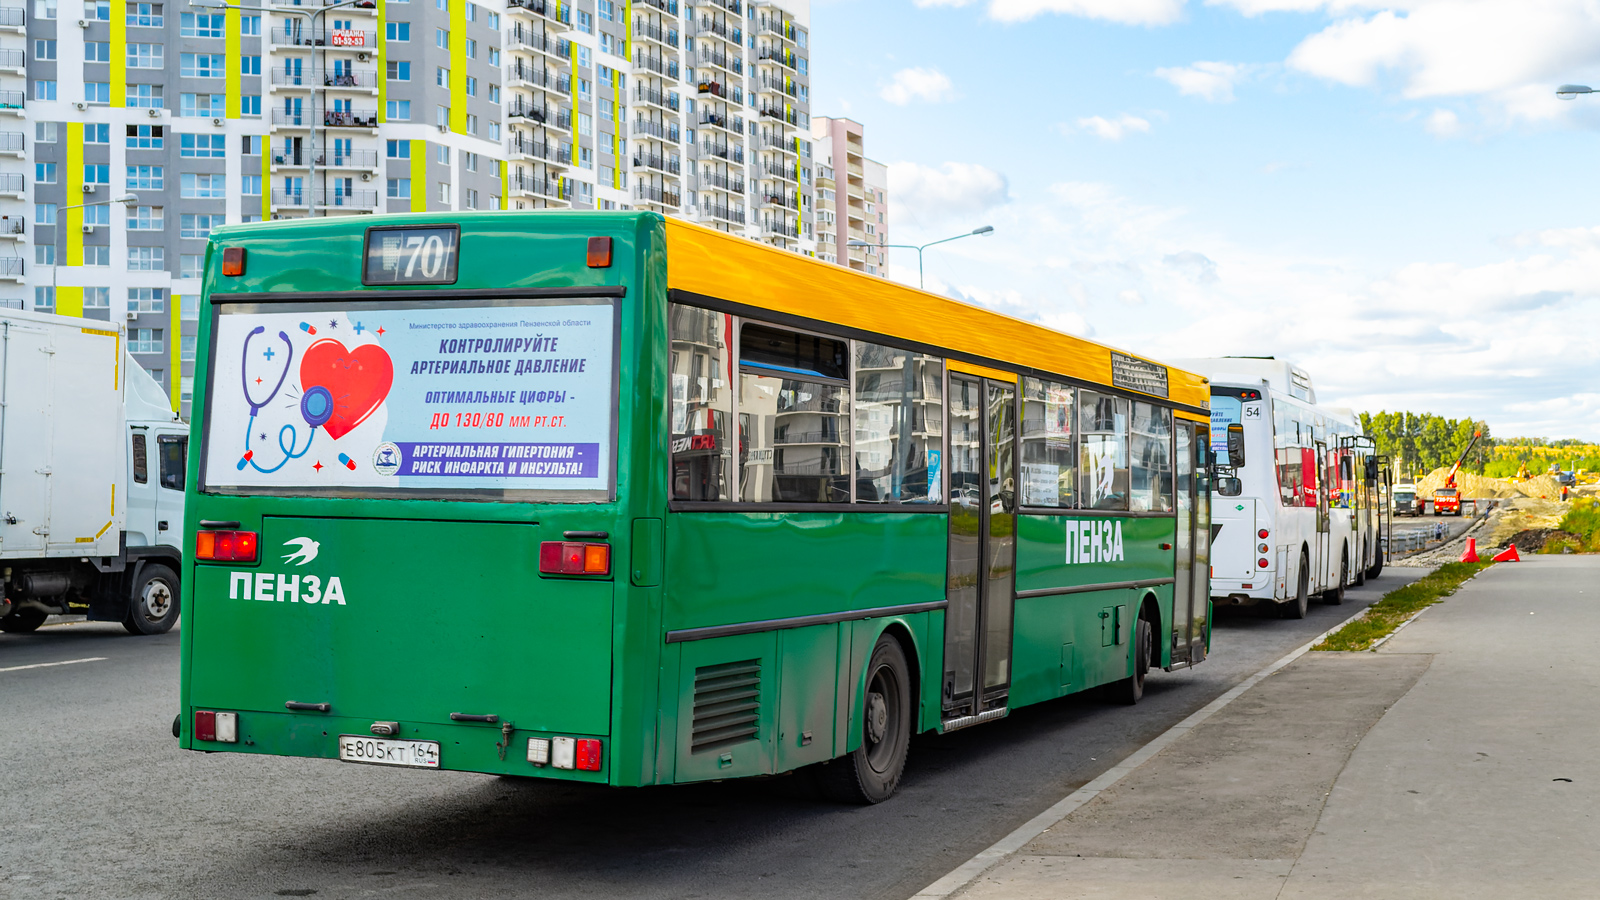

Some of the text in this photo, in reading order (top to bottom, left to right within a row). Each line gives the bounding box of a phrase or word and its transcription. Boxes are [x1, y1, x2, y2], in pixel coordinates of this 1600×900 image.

[404, 235, 444, 278] 70
[409, 319, 592, 330] Министерство здравоохранения Пензенской области
[439, 334, 558, 354] КОНТРОЛИРУЙТЕ
[410, 358, 586, 376] АРТЕРИАЛЬНОЕ ДАВЛЕНИЕ
[425, 390, 516, 404] ОПТИМАЛЬНЫЕ
[519, 390, 566, 406] ЦИФРЫ
[1246, 408, 1260, 416] 54
[430, 413, 450, 430] ДО
[455, 412, 504, 428] 130/80
[534, 416, 567, 428] РТ.СТ.
[412, 445, 498, 458] АРТЕРИАЛЬНАЯ
[502, 446, 575, 458] ГИПЕРТОНИЯ
[412, 461, 582, 475] РИСК ИНФАРКТА И ИНСУЛЬТА!
[1066, 520, 1124, 564] ПЕНЗА
[230, 571, 346, 606] ПЕНЗА
[410, 743, 435, 758] 164
